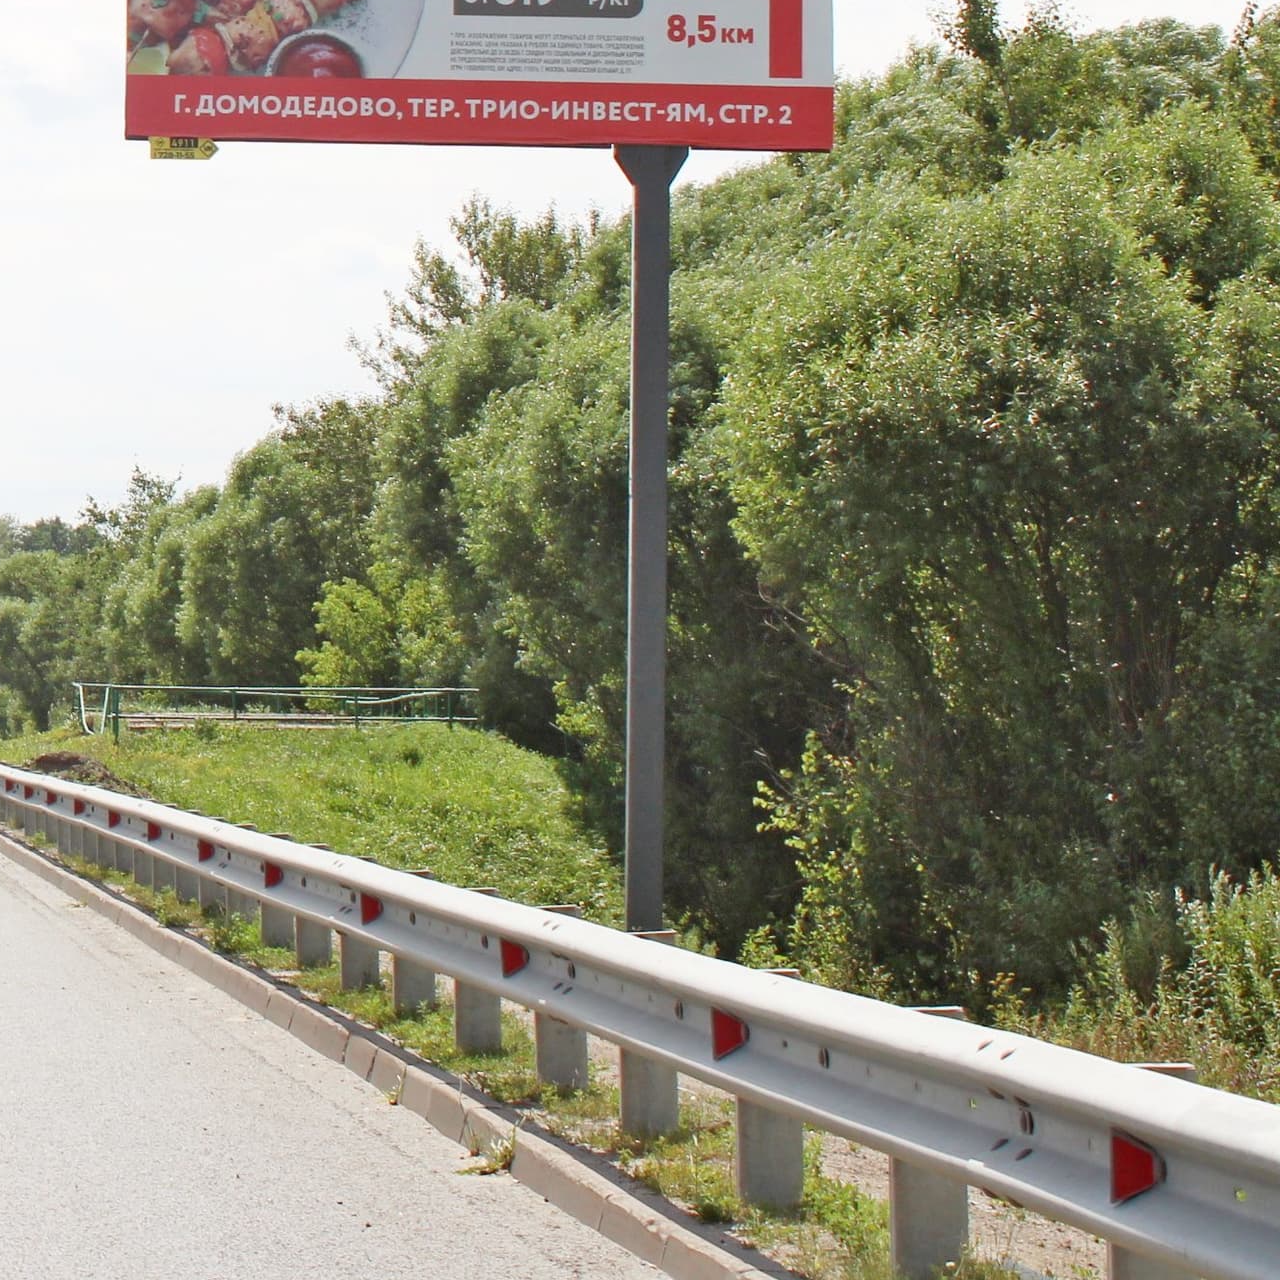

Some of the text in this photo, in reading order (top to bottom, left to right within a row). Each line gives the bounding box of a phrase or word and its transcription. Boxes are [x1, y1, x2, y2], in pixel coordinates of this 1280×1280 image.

[173, 93, 793, 126] Г. ДОМОДЕДОВО, ТЕР. ТРИО-ИНВЕСТ-ЯМ, СТР. 2
